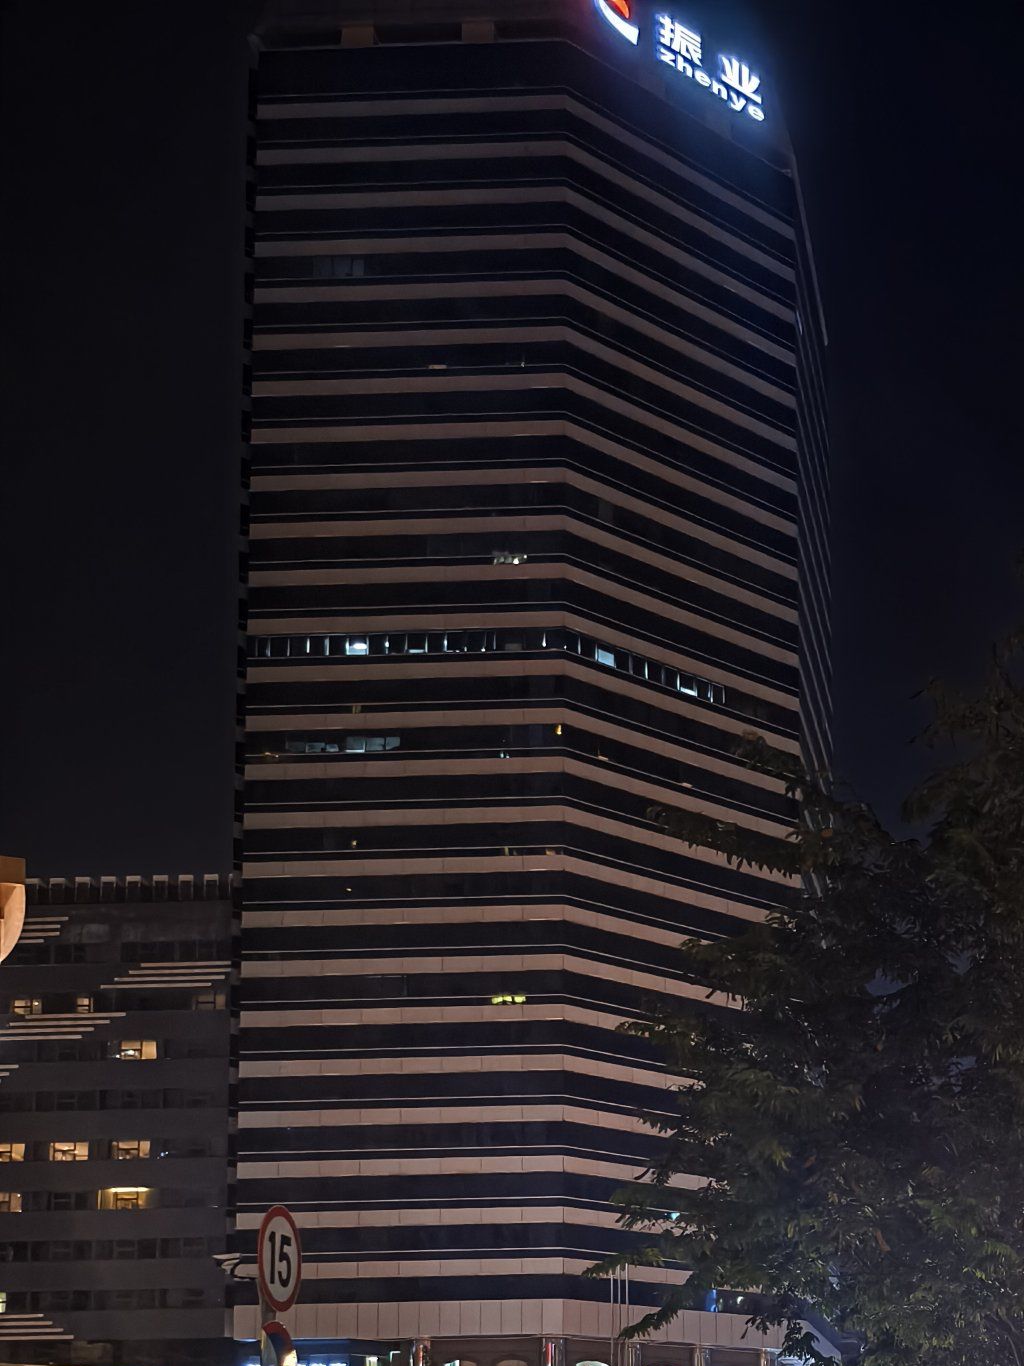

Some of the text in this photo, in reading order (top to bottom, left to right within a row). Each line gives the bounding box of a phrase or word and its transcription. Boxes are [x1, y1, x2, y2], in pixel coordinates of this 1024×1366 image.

[658, 14, 762, 105] 振业
[658, 46, 765, 122] zhenye
[267, 1230, 292, 1288] 15
